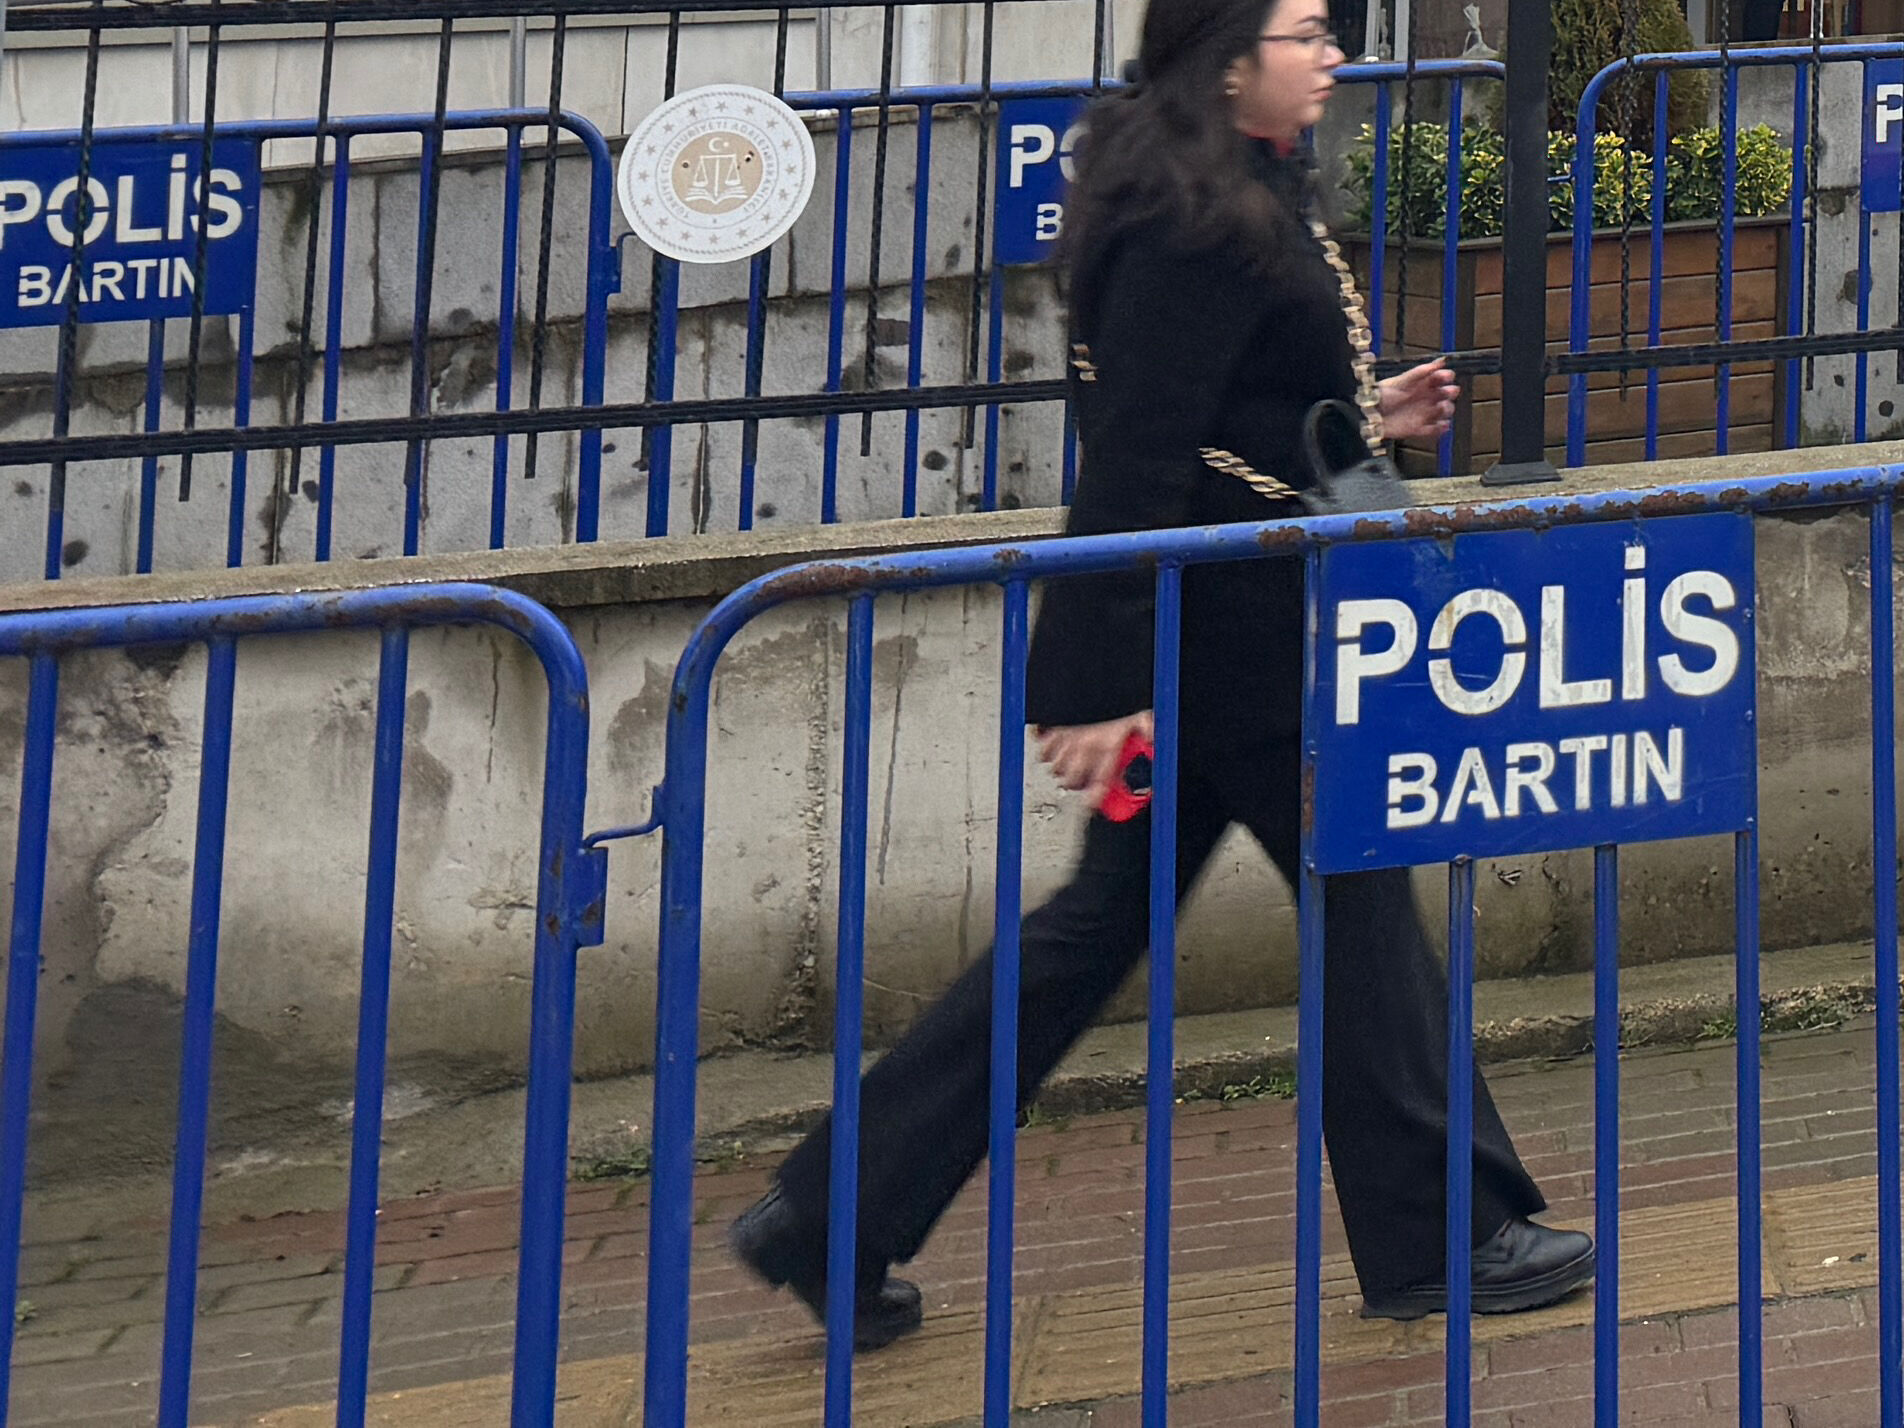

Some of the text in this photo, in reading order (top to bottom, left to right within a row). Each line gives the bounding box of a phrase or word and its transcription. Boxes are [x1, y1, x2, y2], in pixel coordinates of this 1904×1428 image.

[0, 153, 243, 250] POLİS
[17, 256, 197, 308] BARTIN
[1334, 544, 1740, 726] POLİS
[1386, 727, 1684, 831] BARTIN
